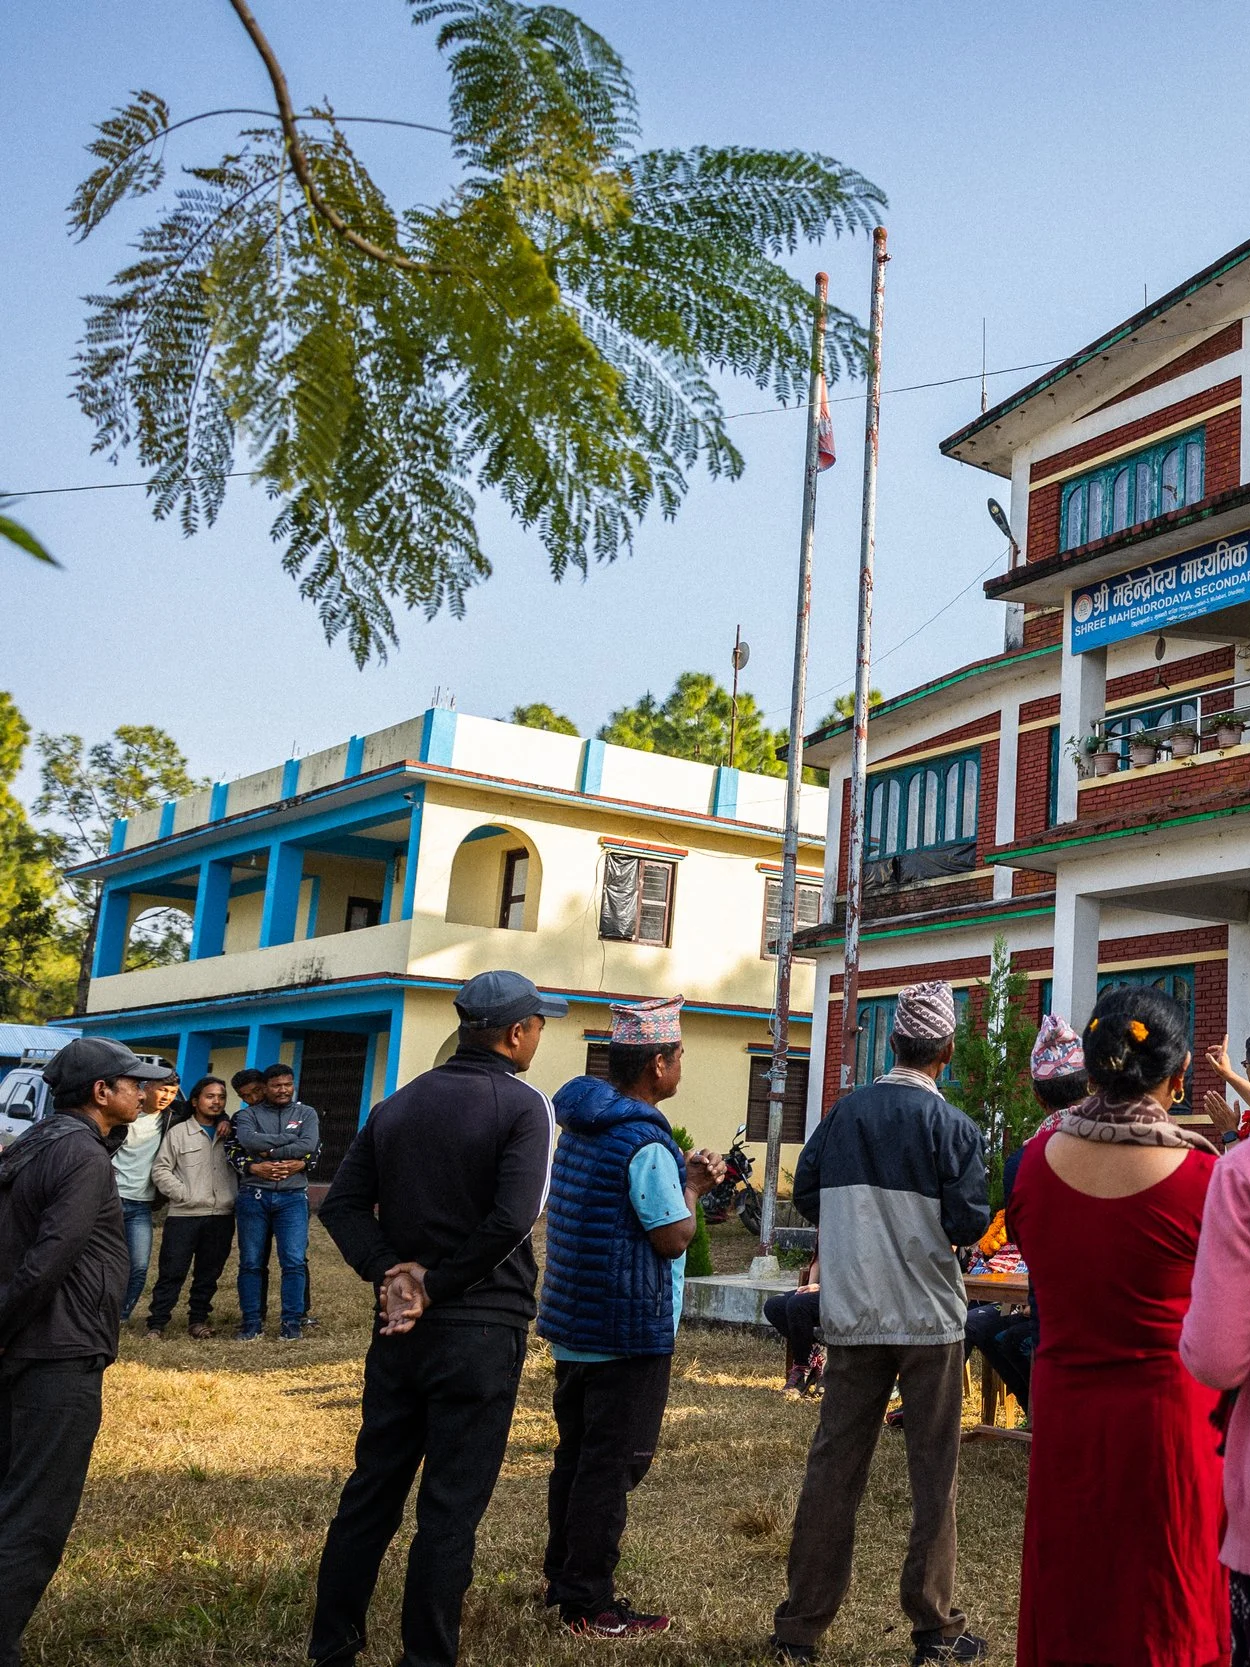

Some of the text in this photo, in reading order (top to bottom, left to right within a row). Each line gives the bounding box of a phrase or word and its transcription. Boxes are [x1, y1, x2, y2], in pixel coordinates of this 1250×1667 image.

[1093, 583, 1110, 616] श्री
[1112, 566, 1177, 607] महेन्द्रोदय
[1180, 541, 1249, 584] माध्यमिक
[1074, 617, 1107, 637] SHREE
[1108, 590, 1192, 625] MAHENDRODAYA
